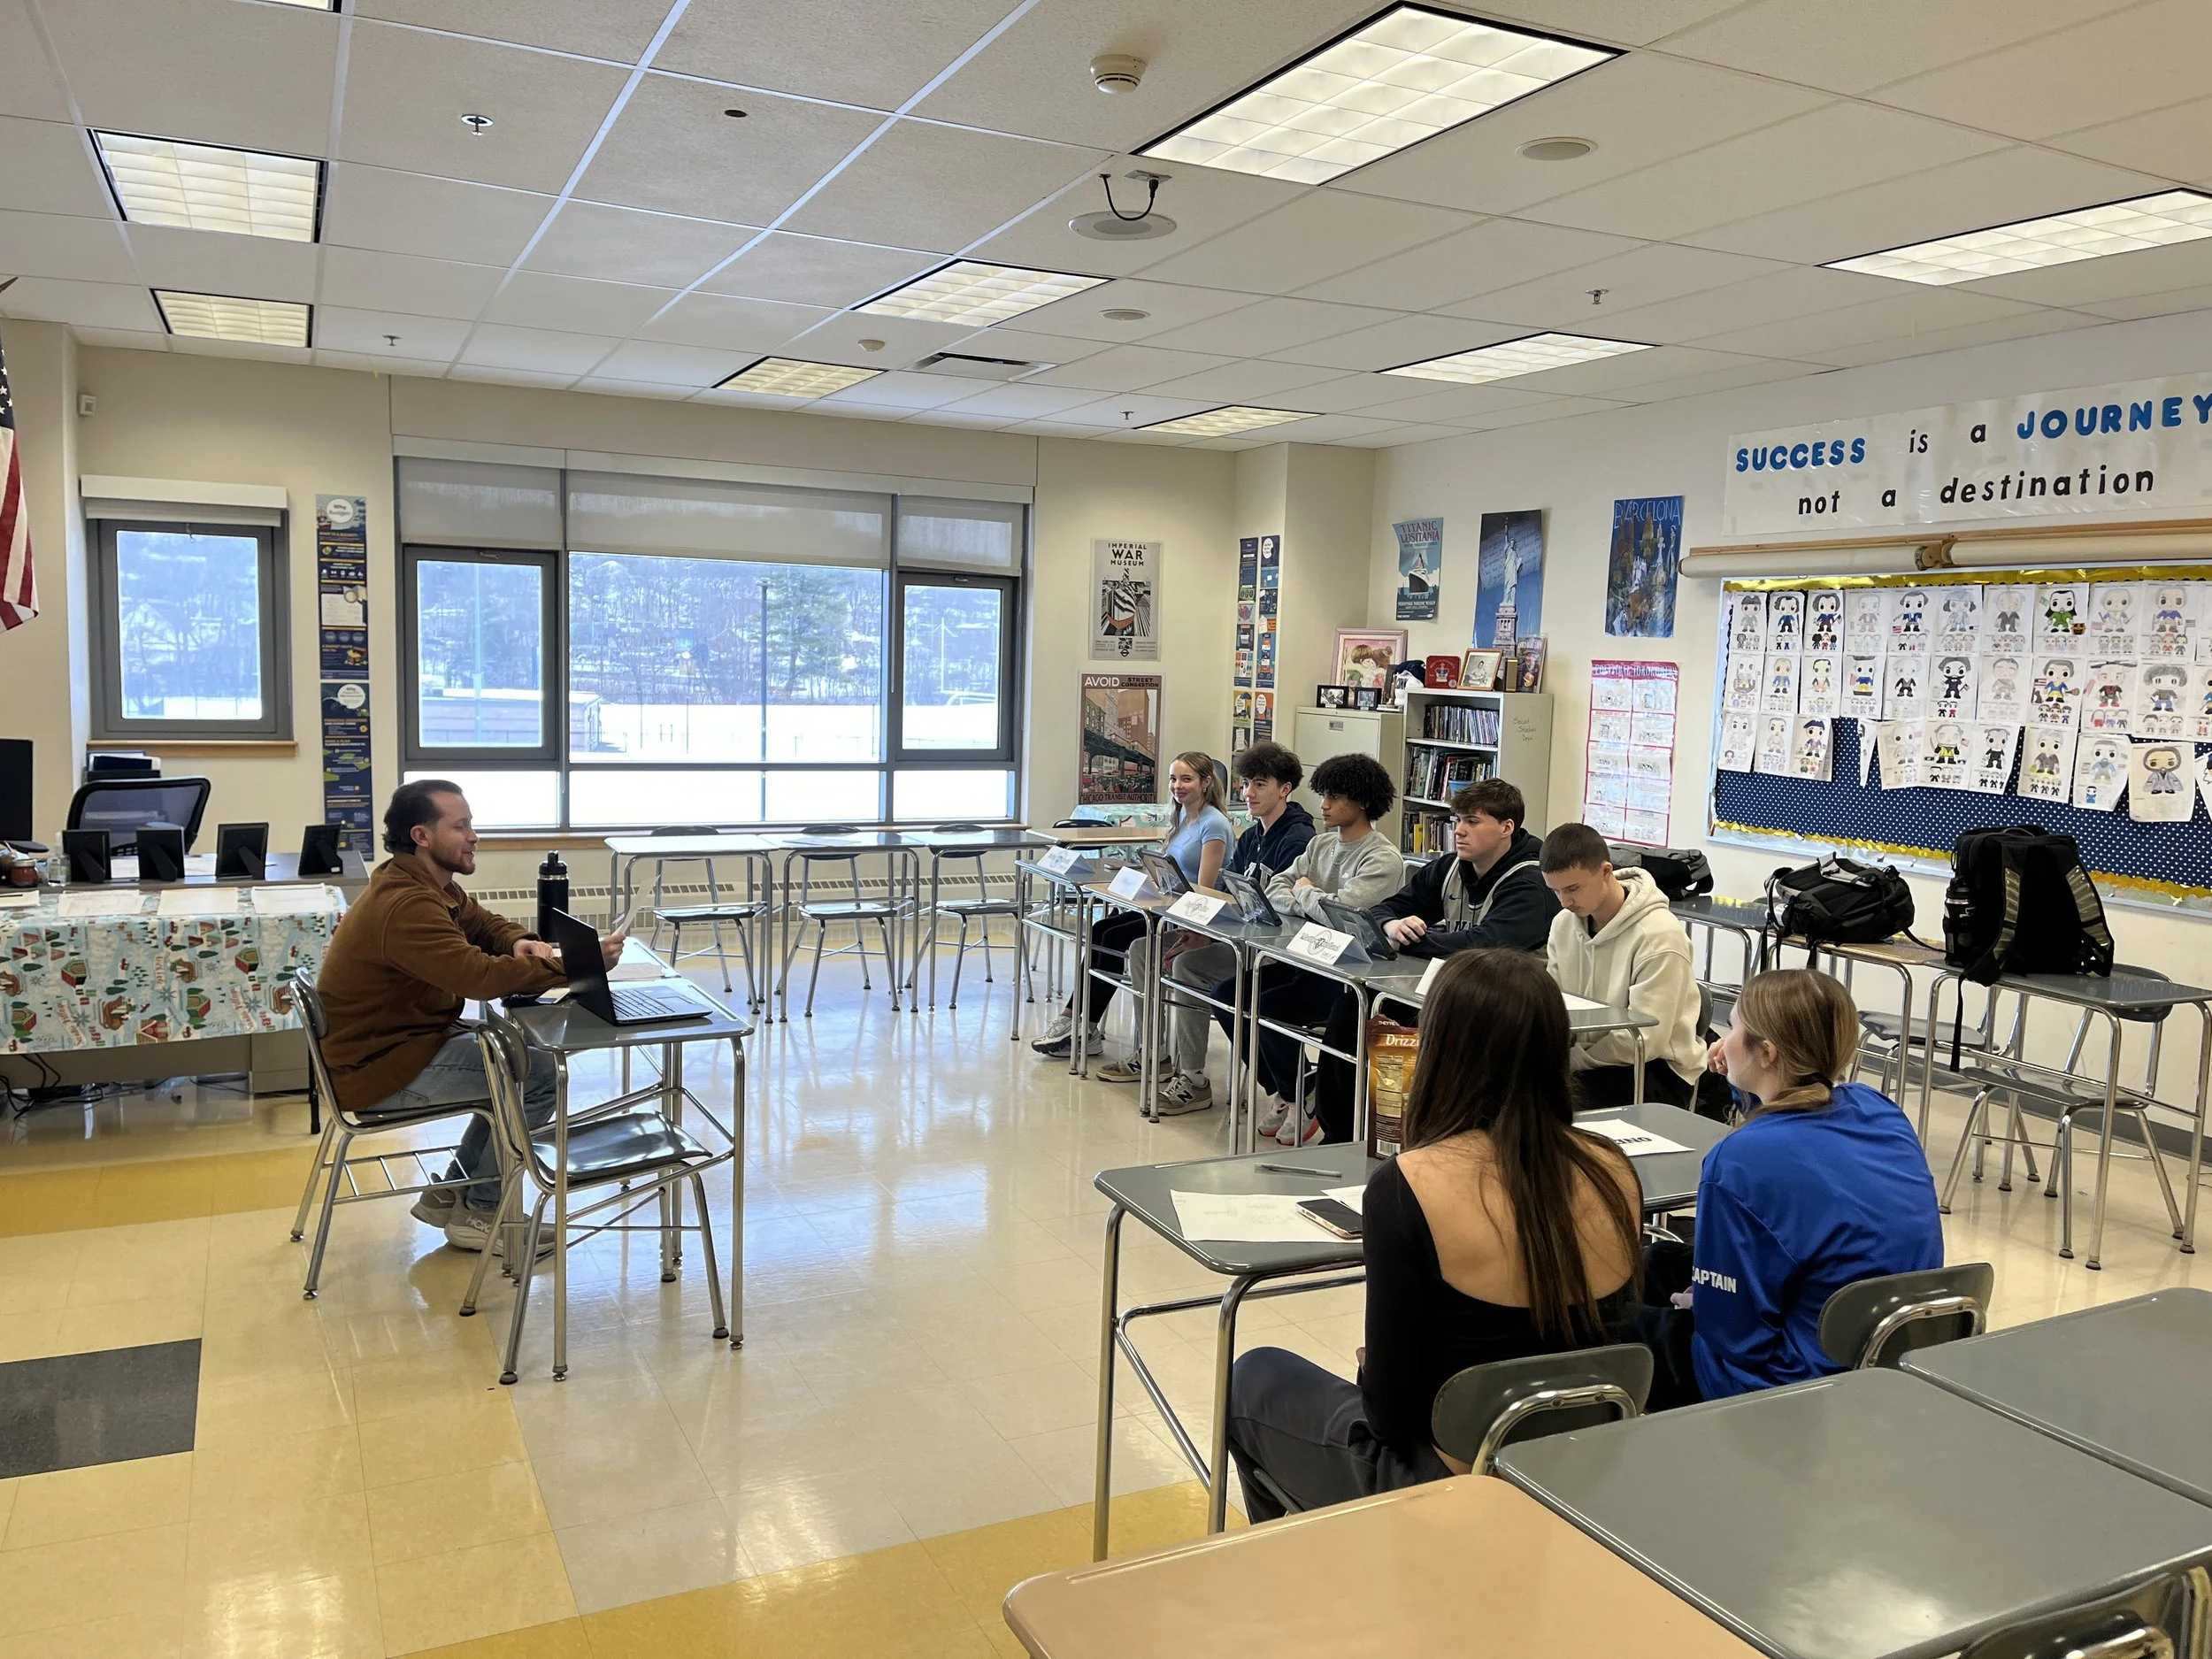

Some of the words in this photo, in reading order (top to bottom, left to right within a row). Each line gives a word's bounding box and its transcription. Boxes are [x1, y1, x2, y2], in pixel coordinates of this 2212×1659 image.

[1736, 438, 1866, 472] SUCCESS
[1909, 429, 1929, 454] is
[1970, 424, 1986, 443] a
[2016, 394, 2212, 440] JOURNEY
[1798, 491, 1840, 515] not
[1881, 489, 1896, 507] a
[1940, 465, 2154, 504] destination
[1614, 500, 1681, 529] BARCELONA
[1400, 520, 1438, 534] TITANIC
[1400, 531, 1440, 543] LUSITANIA
[1111, 549, 1144, 560] WAR
[1084, 676, 1120, 687] AVOID
[1079, 793, 1103, 804] CHICAGO
